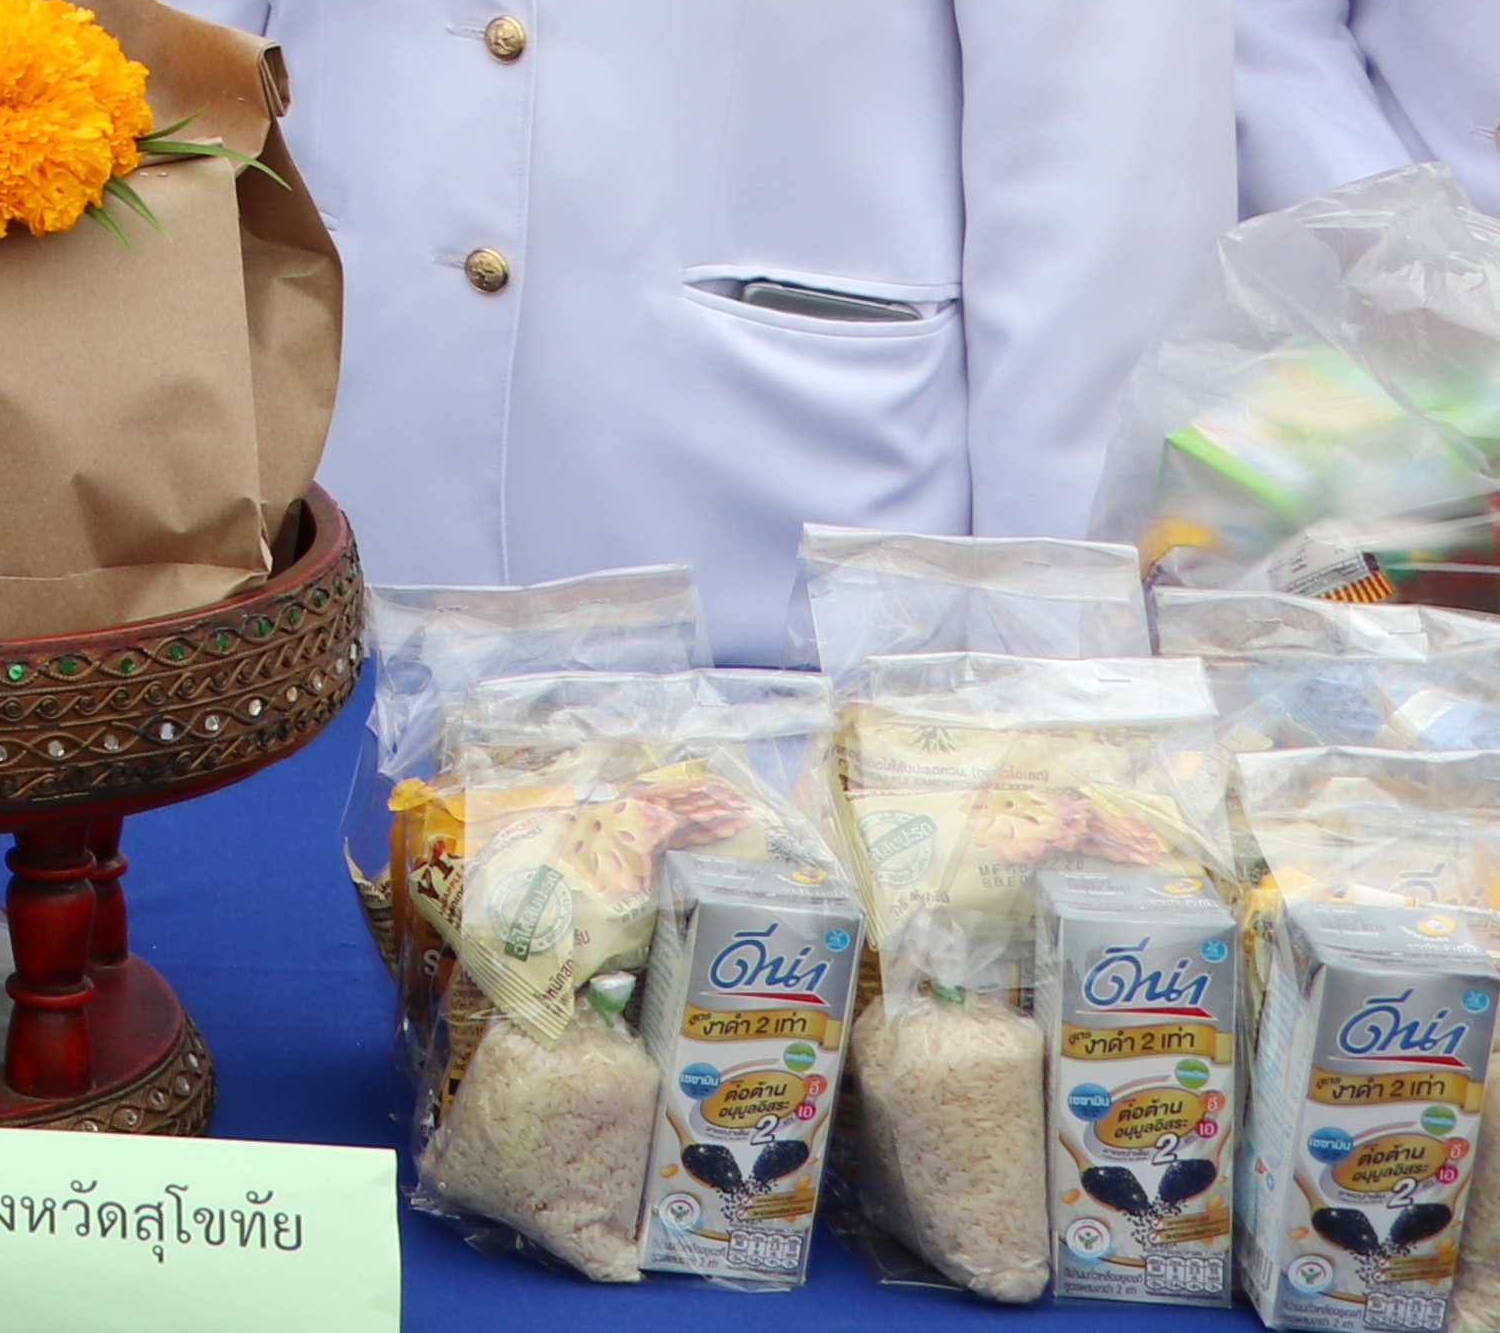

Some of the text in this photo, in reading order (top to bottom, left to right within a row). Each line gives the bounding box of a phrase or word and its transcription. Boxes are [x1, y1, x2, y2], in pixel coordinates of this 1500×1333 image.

[708, 922, 828, 991] ดีน่า
[1083, 936, 1210, 1007] ดีน่า
[703, 1014, 751, 1035] งาดำ
[755, 1016, 770, 1033] 2
[774, 1012, 807, 1033] เท่า
[1337, 988, 1469, 1056] ดีน่า
[1085, 1030, 1136, 1055] งาดำ
[1141, 1033, 1155, 1051] 2
[1161, 1027, 1195, 1049] เท่า
[724, 1081, 788, 1103] ต่อต้าน
[1332, 1077, 1384, 1099] งาดำ
[1389, 1080, 1405, 1097] 2
[1410, 1074, 1446, 1096] เท่า
[718, 1100, 791, 1120] อนุมูลอิสระ
[1117, 1099, 1184, 1123] ต่อต้าน
[750, 1113, 781, 1146] 2
[1114, 1118, 1189, 1141] อนุมูลอิสระ
[1151, 1132, 1181, 1166] 2
[1357, 1144, 1427, 1167] ต่อต้าน
[1352, 1163, 1431, 1184] อนุมูลอิสระ
[1386, 1177, 1418, 1209] 2
